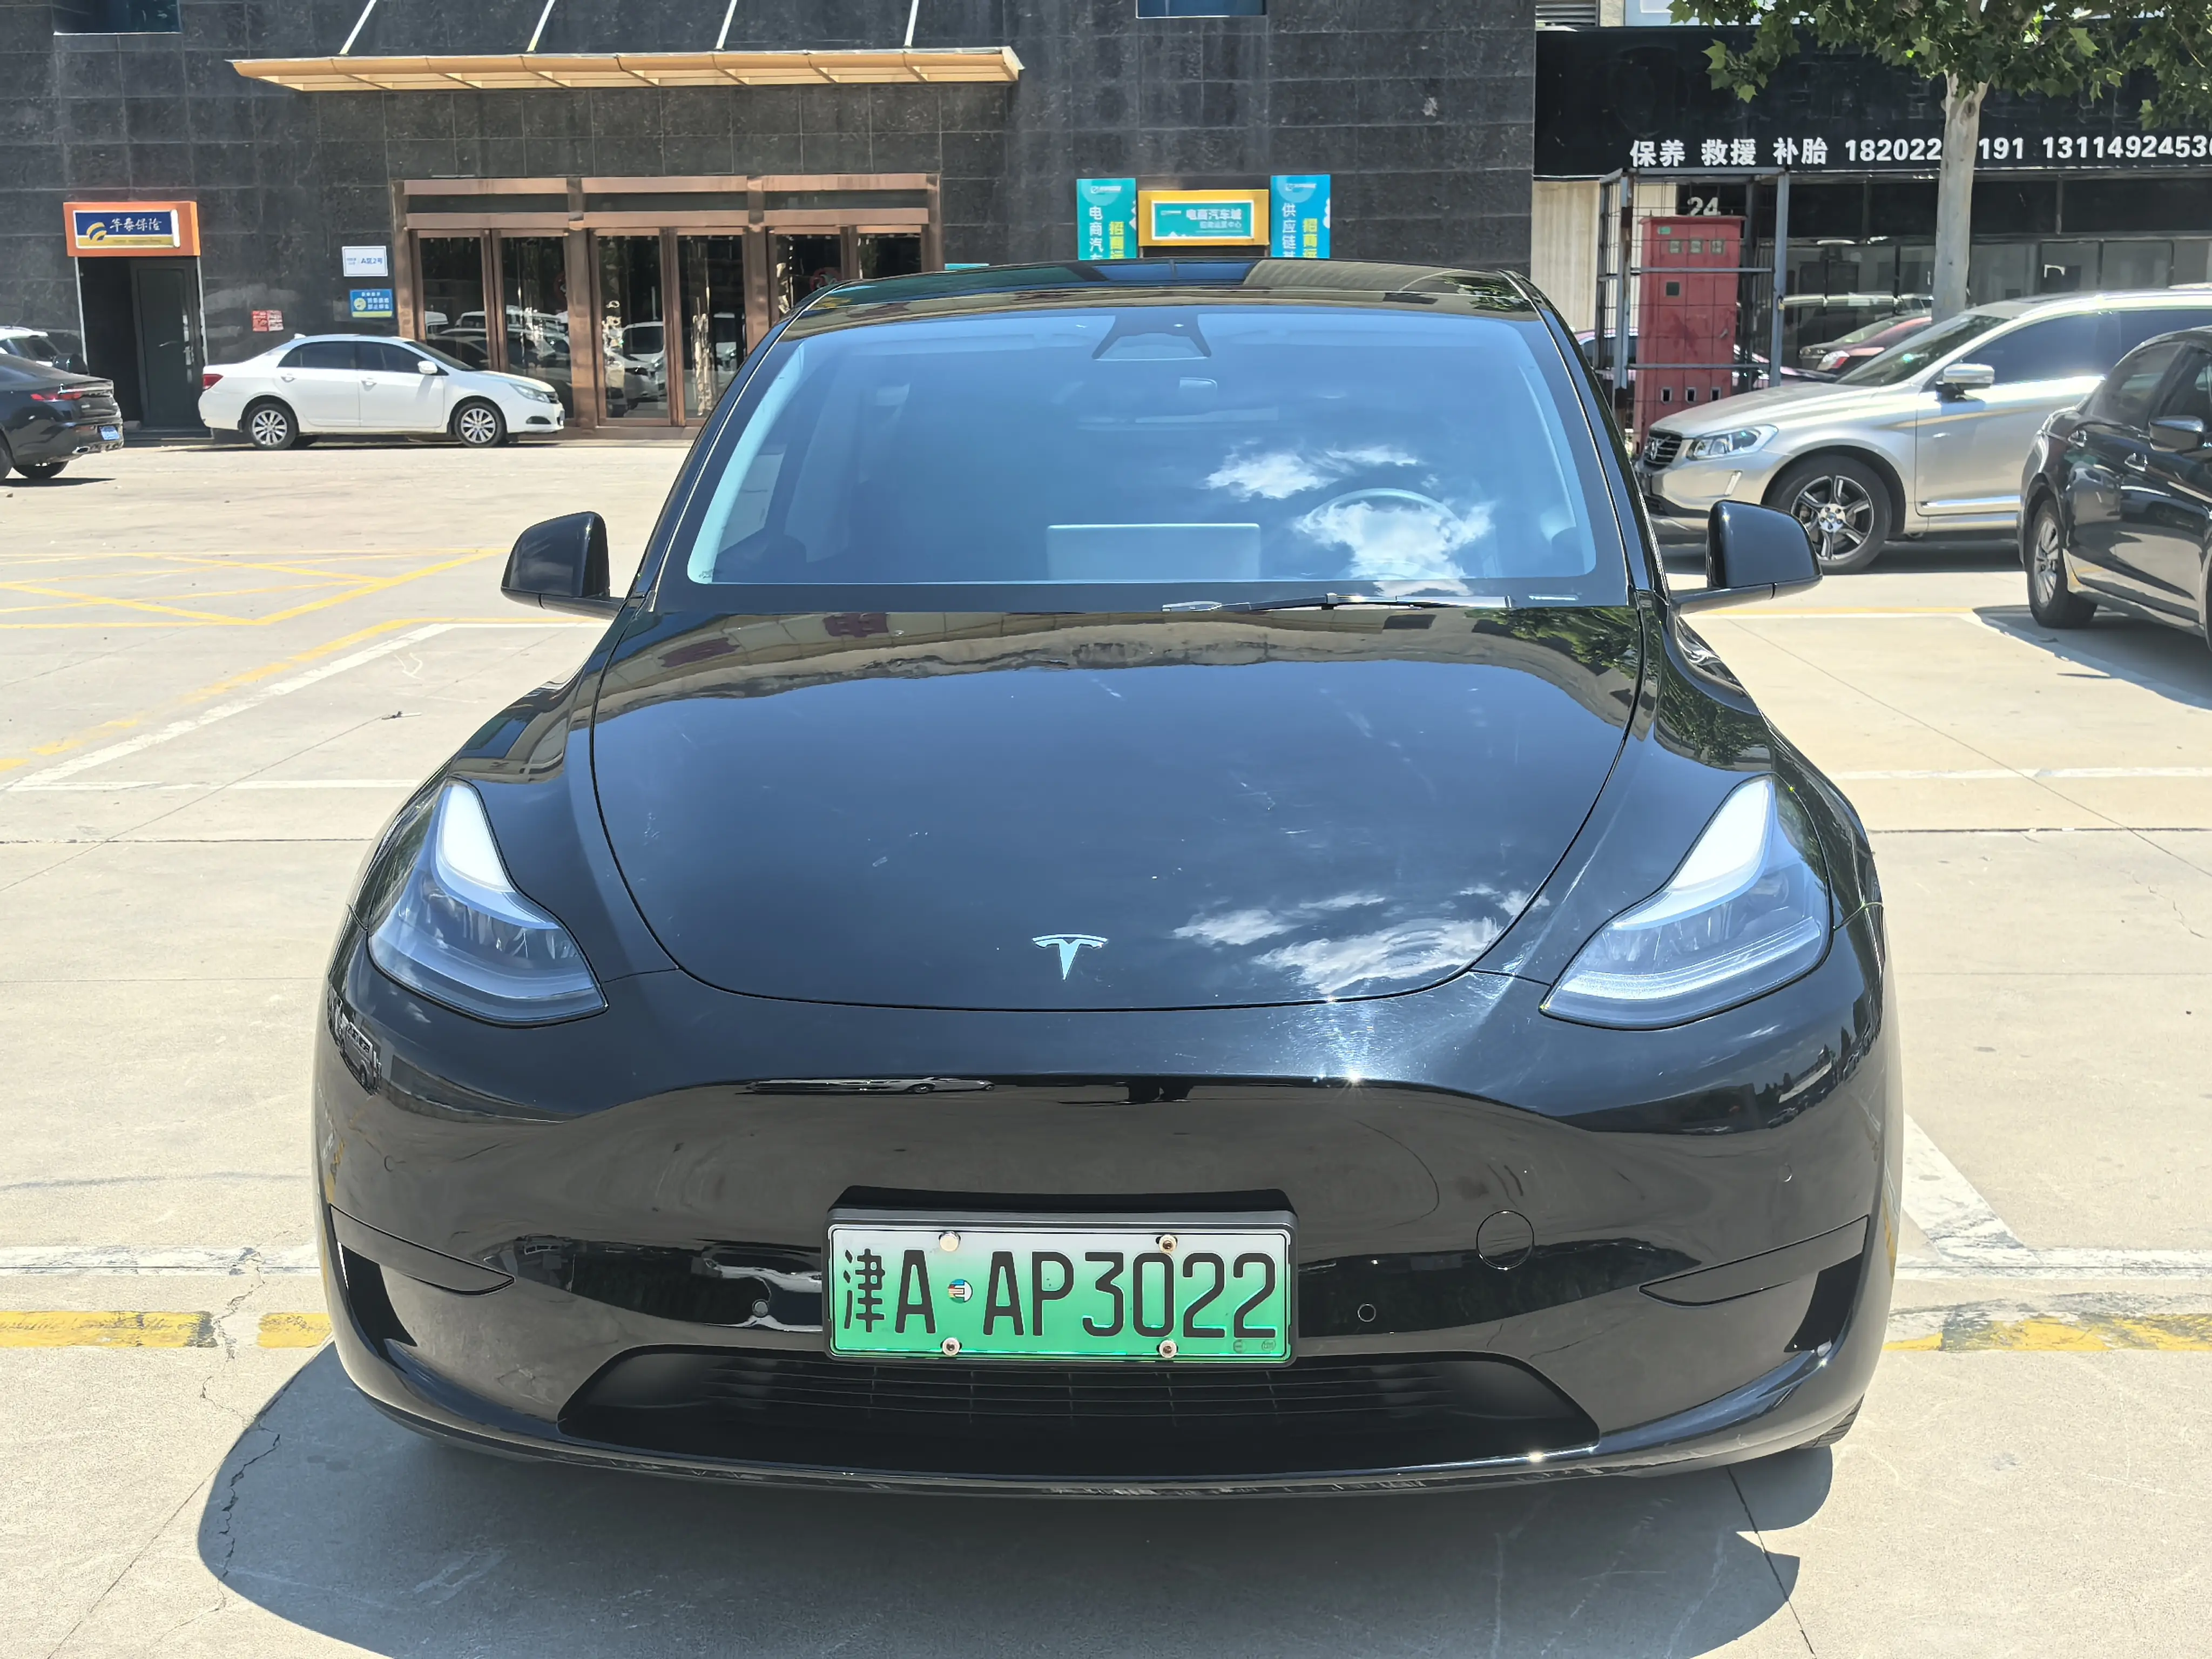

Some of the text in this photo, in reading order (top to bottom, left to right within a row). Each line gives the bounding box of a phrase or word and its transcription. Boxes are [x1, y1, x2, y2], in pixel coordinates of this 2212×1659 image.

[1630, 136, 2212, 167] 保养 救援 补胎 182022191 1311492453
[1687, 197, 1721, 216] 24
[983, 1251, 1276, 1338] AP3022
